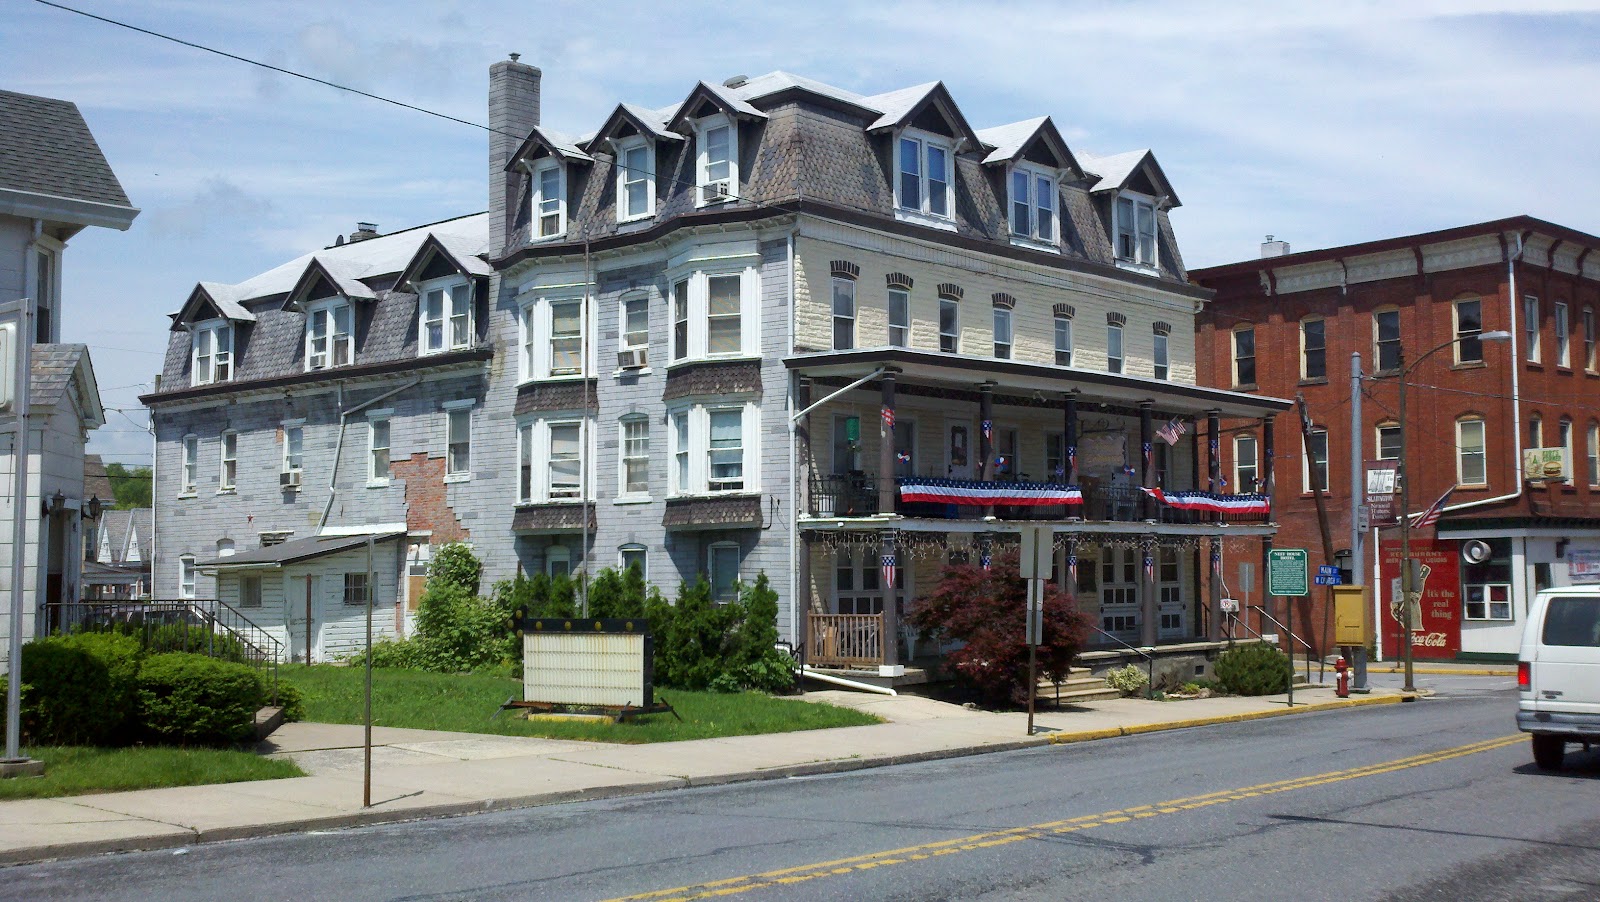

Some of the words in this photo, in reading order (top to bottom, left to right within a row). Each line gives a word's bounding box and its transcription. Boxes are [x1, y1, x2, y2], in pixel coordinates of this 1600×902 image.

[1427, 589, 1439, 598] It's
[1441, 589, 1454, 598] the
[1433, 599, 1449, 608] real
[1431, 609, 1452, 621] thing
